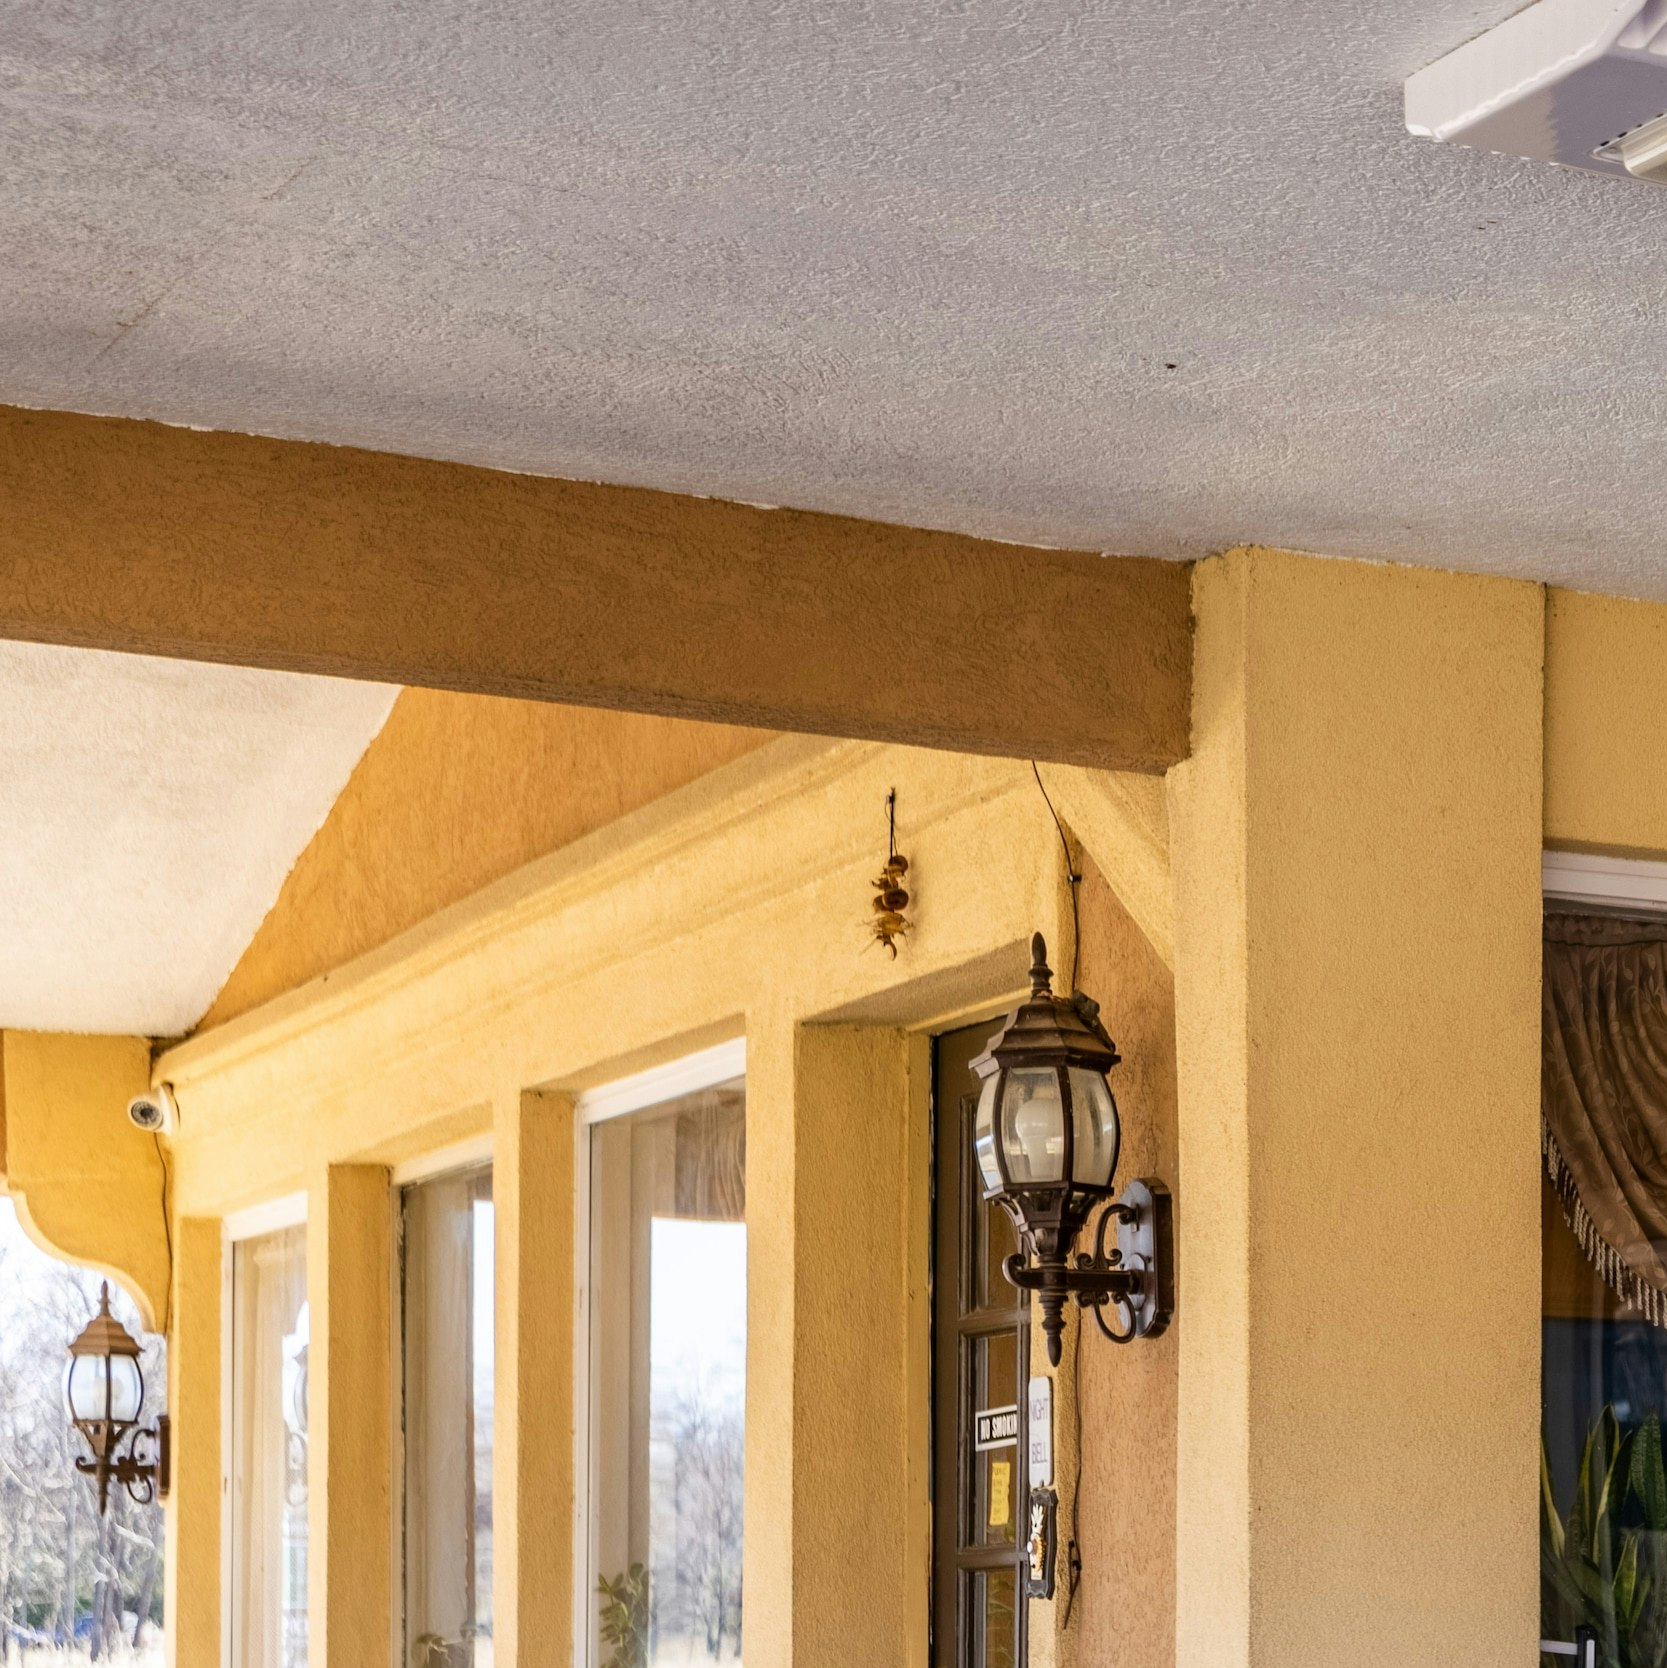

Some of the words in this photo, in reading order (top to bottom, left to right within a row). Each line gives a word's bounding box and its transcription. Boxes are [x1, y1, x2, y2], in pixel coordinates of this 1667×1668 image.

[1030, 1398, 1049, 1421] NIGHT
[981, 1418, 991, 1441] NO
[992, 1413, 1017, 1438] SMOKIN
[1032, 1442, 1048, 1464] BELL
